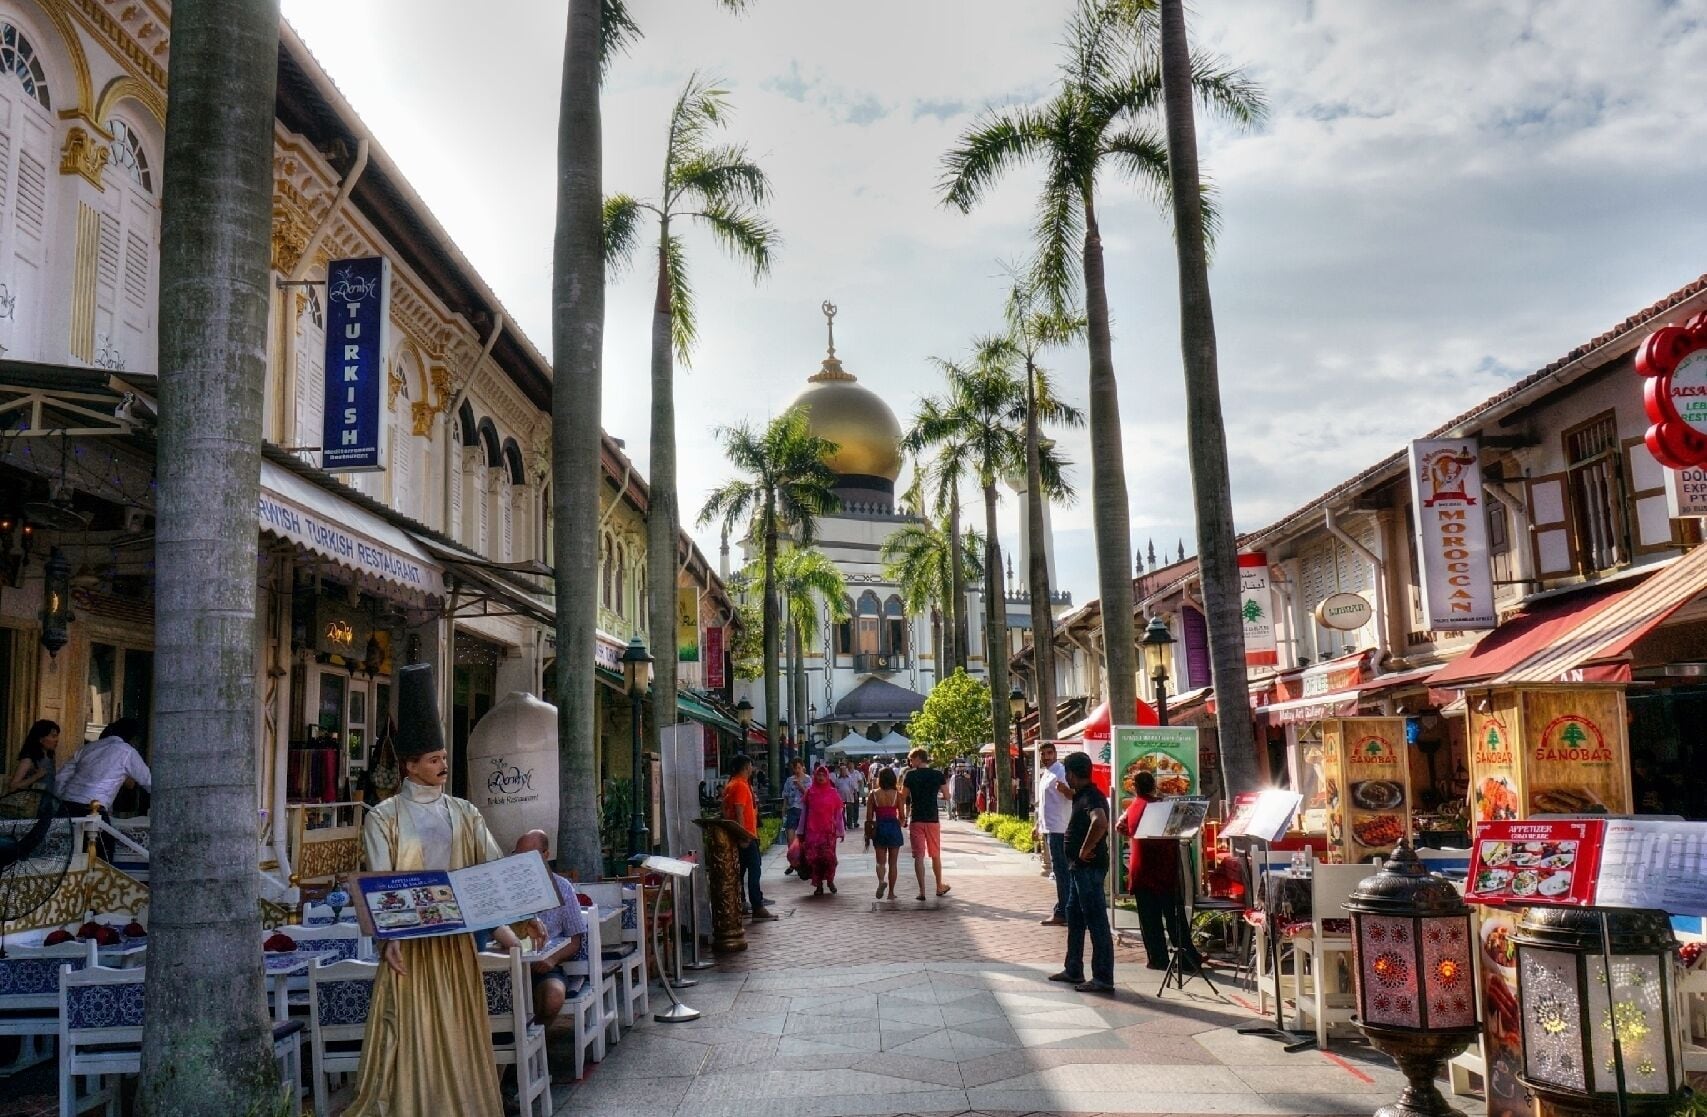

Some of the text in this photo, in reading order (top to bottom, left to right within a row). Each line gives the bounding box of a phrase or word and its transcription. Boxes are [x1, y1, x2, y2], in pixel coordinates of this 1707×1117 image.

[341, 302, 361, 446] TURKISH
[305, 519, 353, 559] TURKISH
[357, 543, 420, 583] RESTAURANT
[1438, 509, 1475, 613] MOROCCAN
[1350, 755, 1398, 763] SANOBAR
[1475, 752, 1513, 763] SANOBAR
[1535, 748, 1613, 761] SANOBAR
[1508, 825, 1553, 833] APPETIZER
